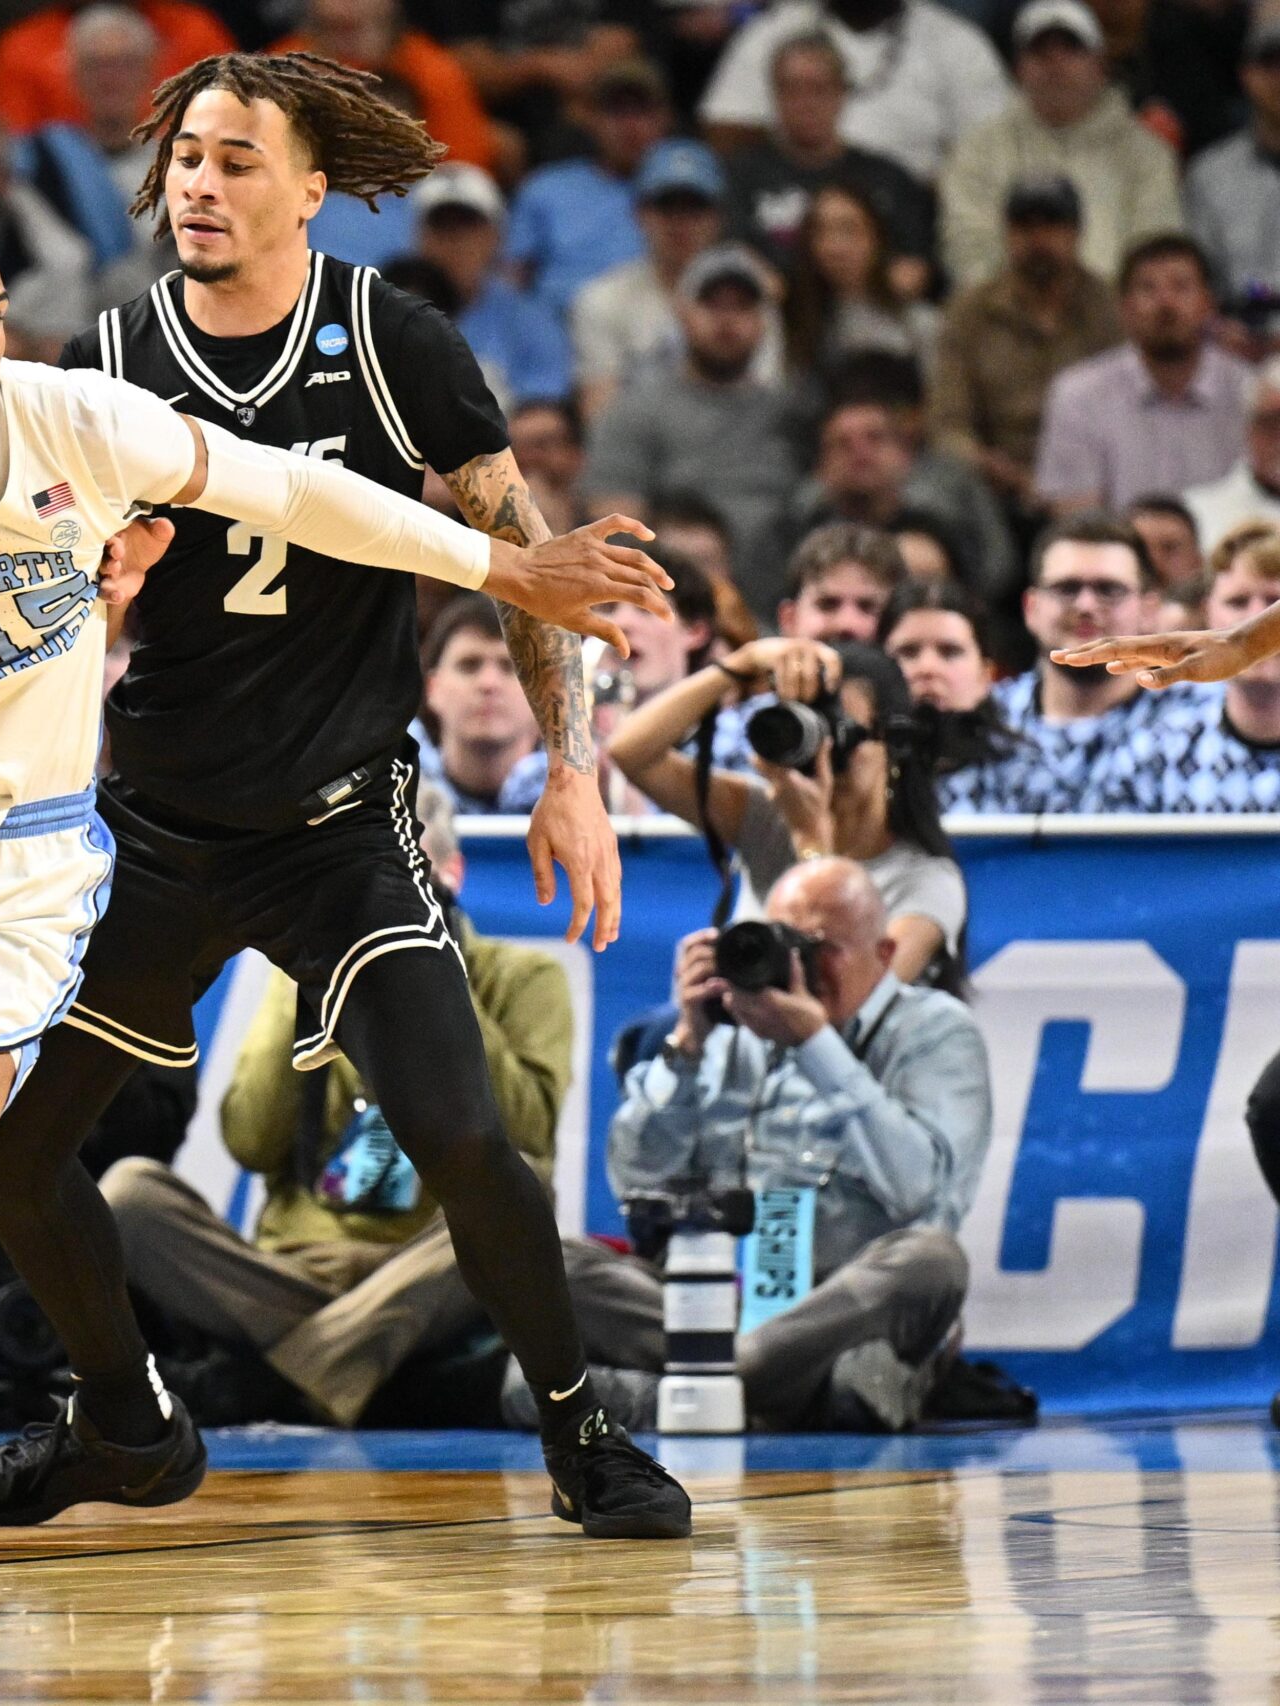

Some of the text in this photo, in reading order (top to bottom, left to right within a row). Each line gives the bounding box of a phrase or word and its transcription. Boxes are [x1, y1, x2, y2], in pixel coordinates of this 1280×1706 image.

[320, 336, 348, 349] NCAA
[304, 370, 351, 388] A10
[223, 520, 287, 616] 2
